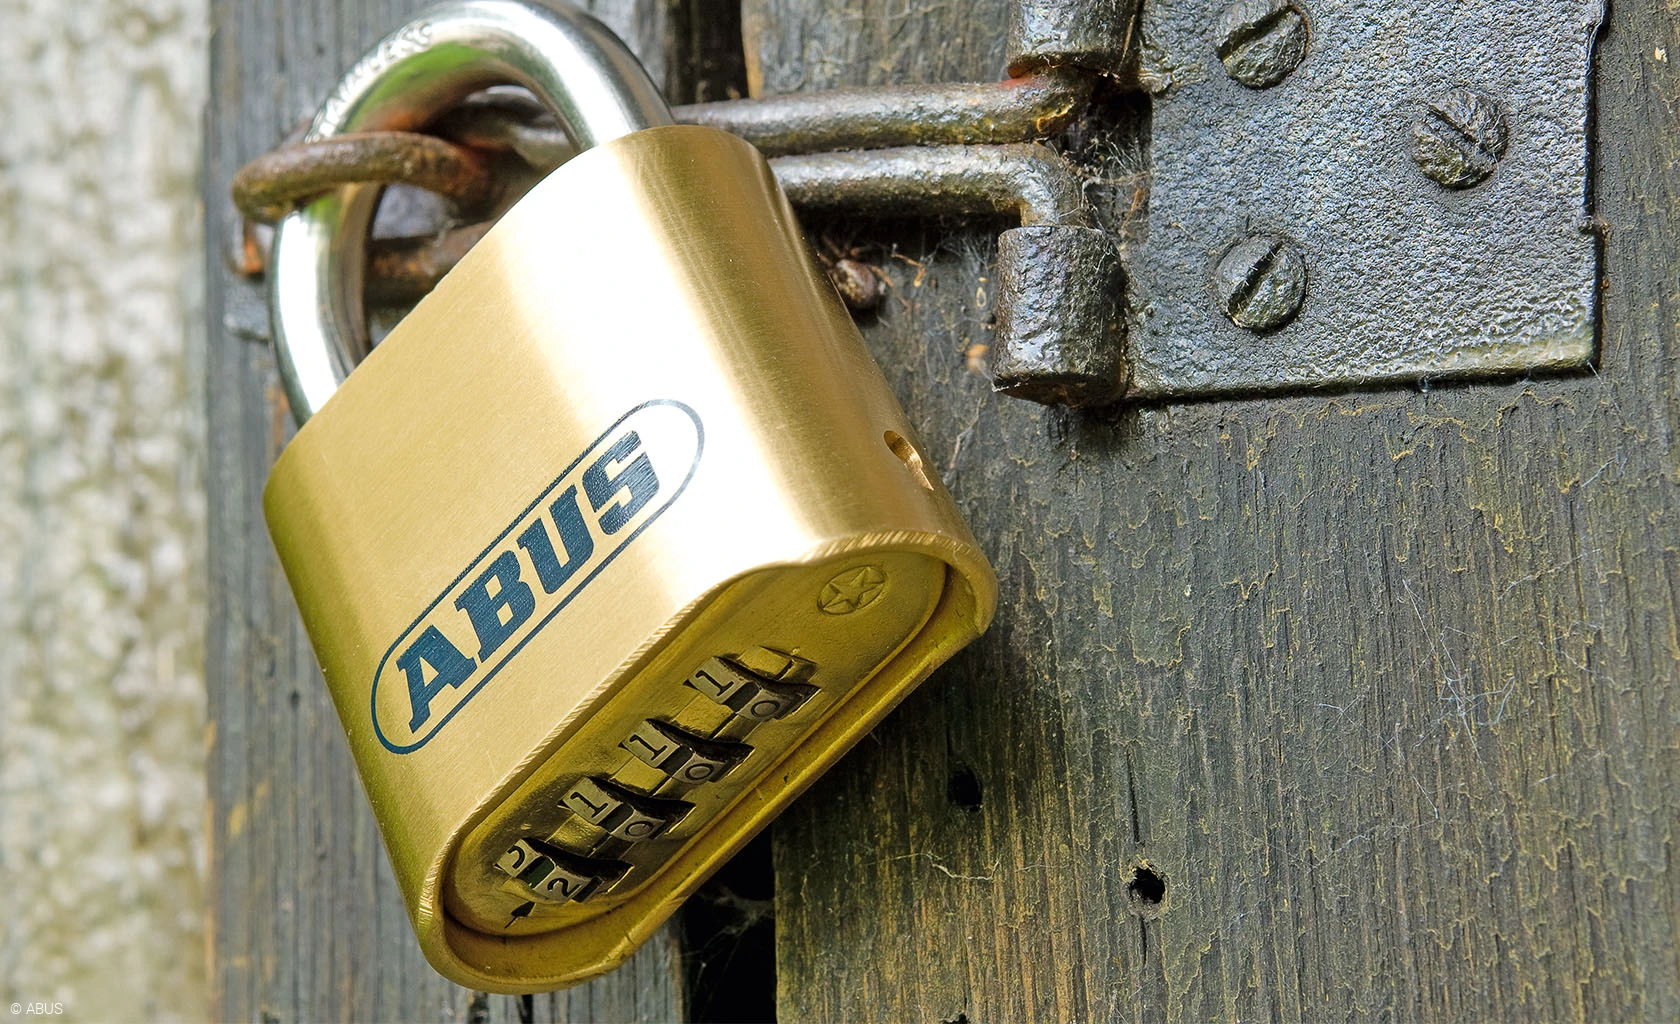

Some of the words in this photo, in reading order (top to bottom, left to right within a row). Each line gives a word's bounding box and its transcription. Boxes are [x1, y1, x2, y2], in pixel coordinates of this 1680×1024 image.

[395, 430, 660, 734] ABUS
[547, 877, 582, 897] 2
[625, 820, 654, 837] 0
[684, 763, 714, 780] 0
[750, 700, 781, 717] 0
[570, 791, 609, 818] 1
[629, 734, 668, 761] 1
[695, 670, 735, 696] 1
